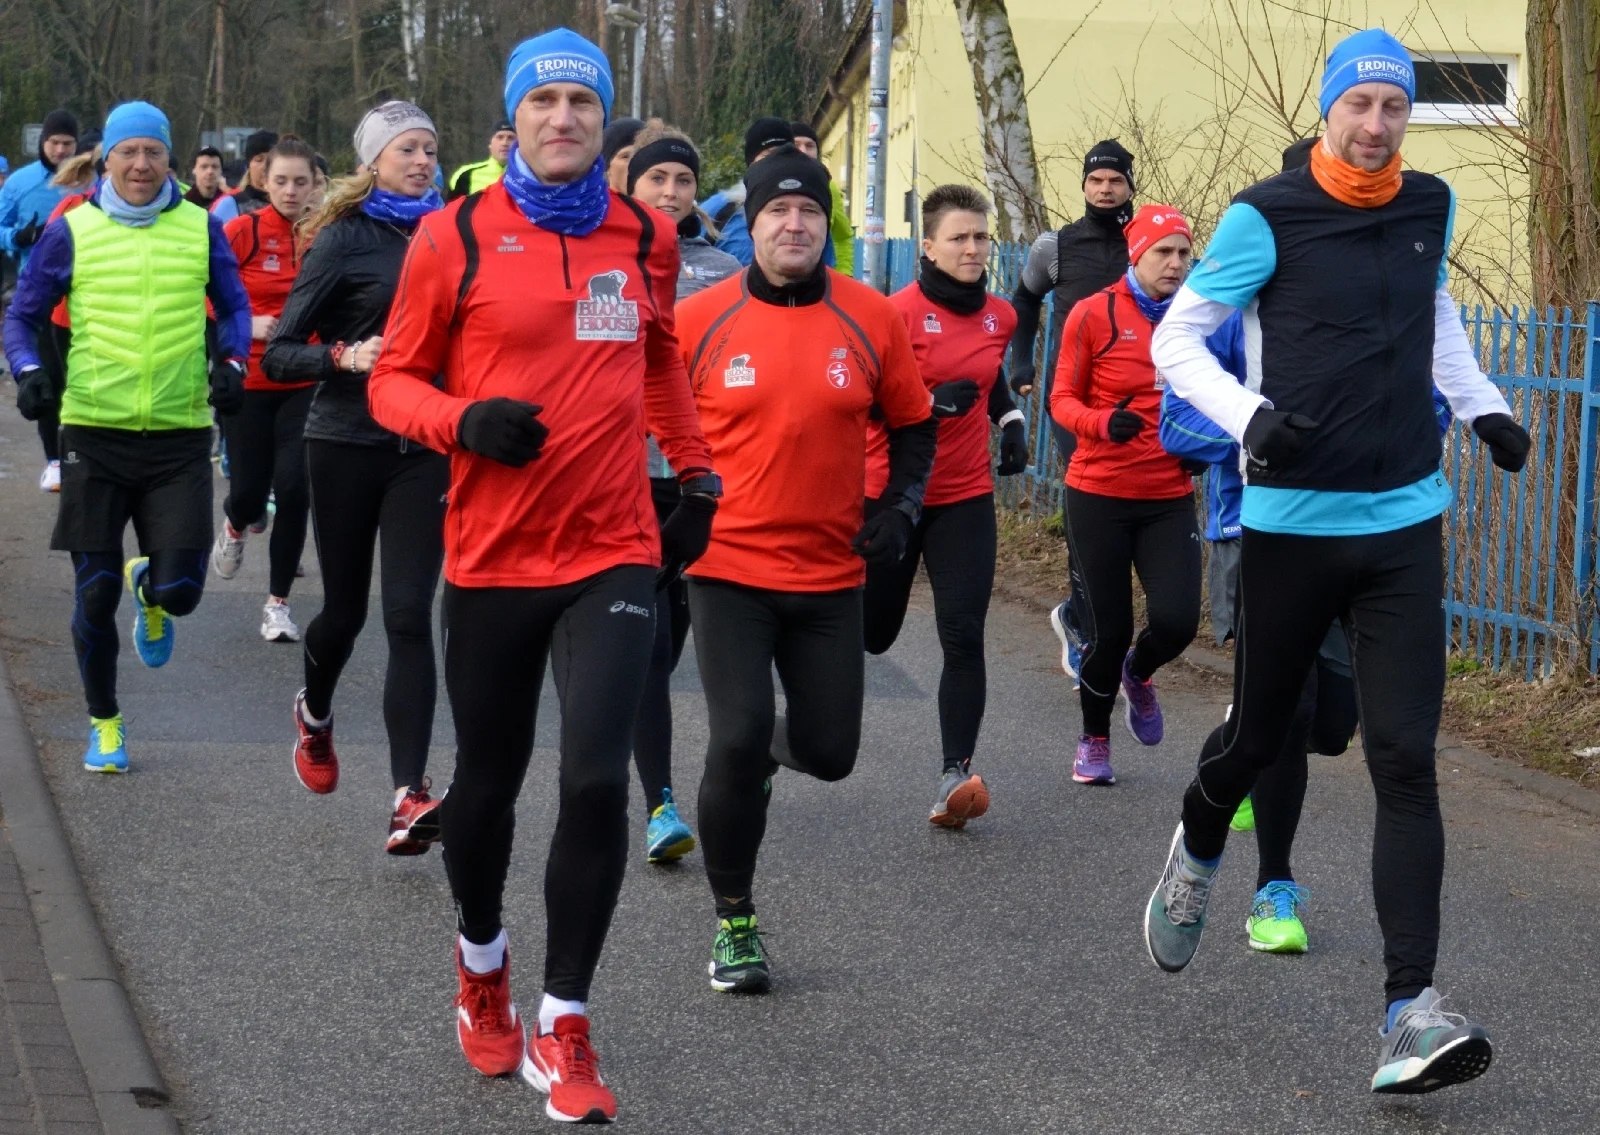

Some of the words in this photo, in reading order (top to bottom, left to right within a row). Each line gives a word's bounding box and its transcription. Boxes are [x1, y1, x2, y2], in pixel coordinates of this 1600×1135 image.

[536, 59, 598, 79] ERDINGER
[1357, 61, 1411, 79] ERDINGER
[578, 302, 637, 316] BLOCK
[578, 316, 638, 331] HOUSE
[625, 603, 650, 618] asics
